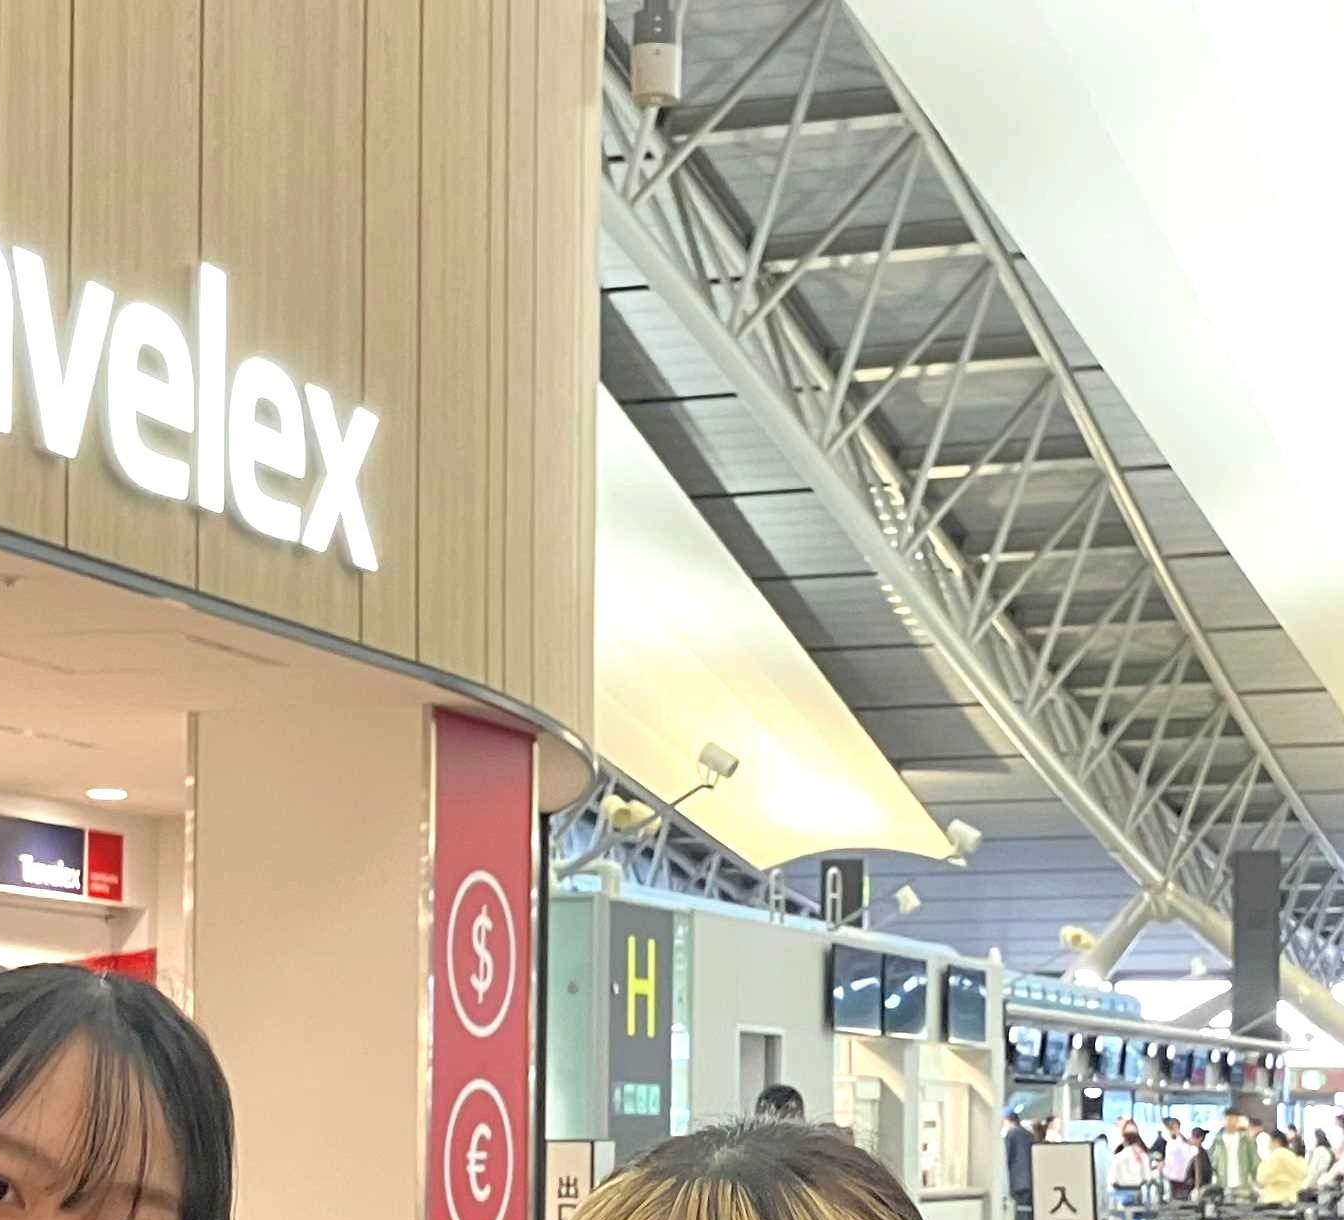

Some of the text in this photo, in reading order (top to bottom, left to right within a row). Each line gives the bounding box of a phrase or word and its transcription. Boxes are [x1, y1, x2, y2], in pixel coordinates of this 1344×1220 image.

[469, 903, 494, 1004] $
[626, 934, 656, 1039] H
[465, 1122, 493, 1203] €
